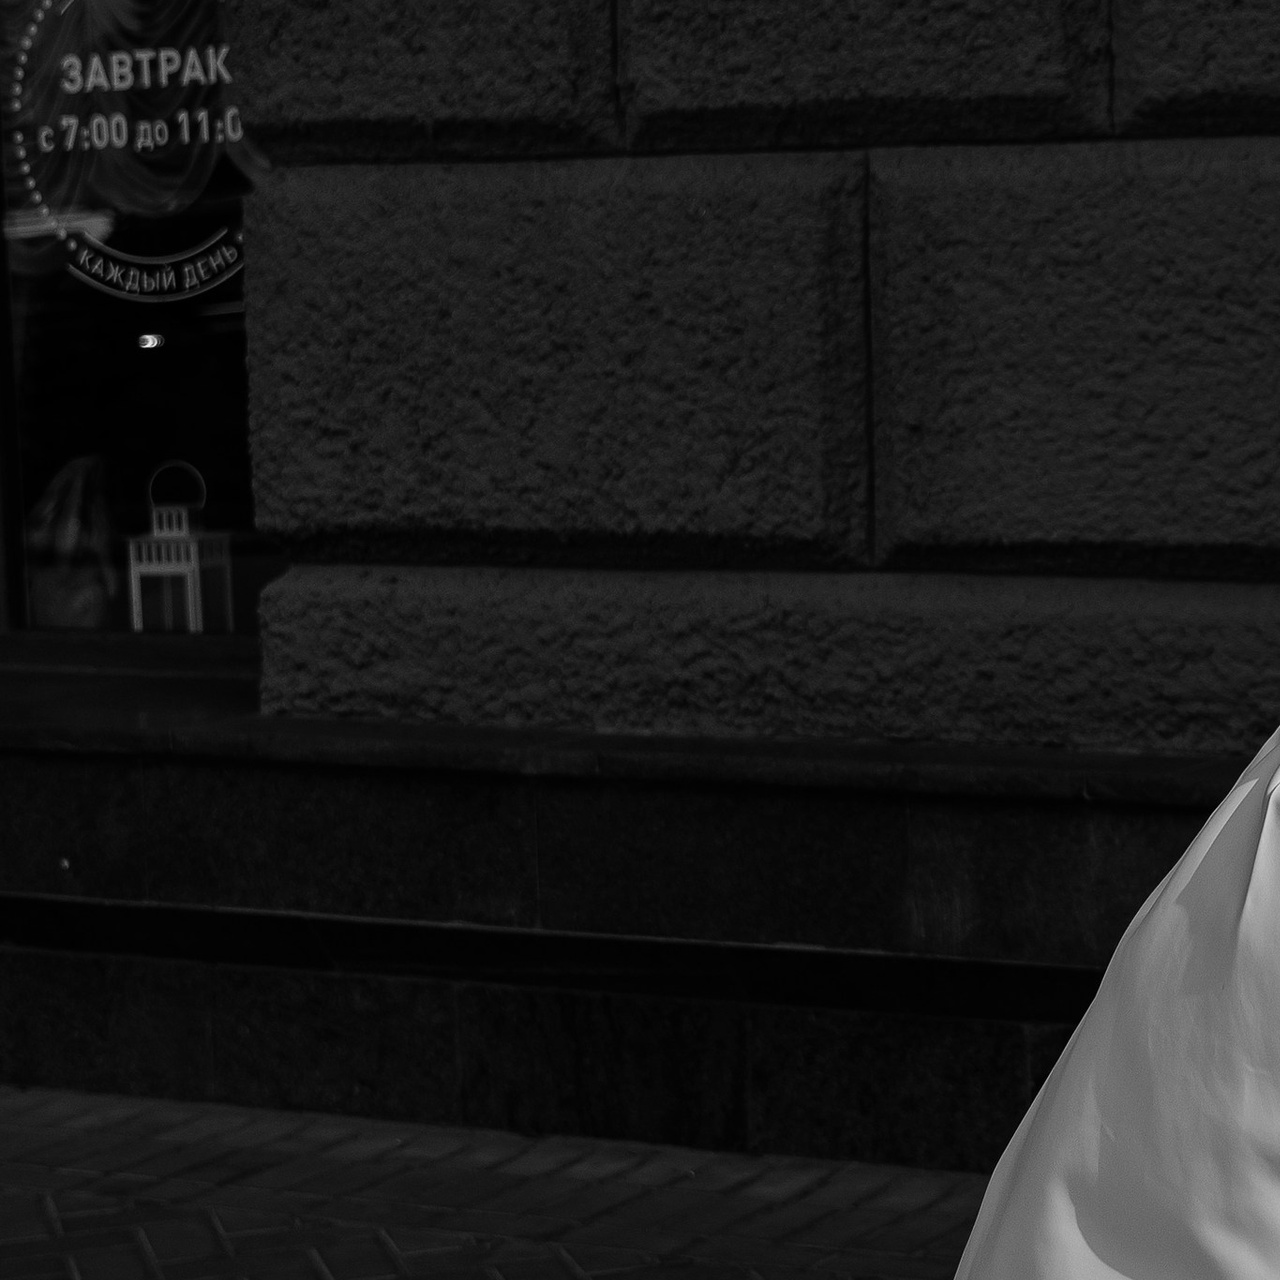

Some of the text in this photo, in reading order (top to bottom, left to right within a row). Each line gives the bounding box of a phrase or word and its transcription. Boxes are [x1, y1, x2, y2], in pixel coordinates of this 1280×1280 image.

[60, 44, 233, 95] ЗАВТРАК
[59, 111, 128, 151] 7:00
[134, 120, 169, 153] до
[175, 105, 244, 145] 11:0
[77, 243, 239, 295] КАЖДЫЙ ДЕНЬ
